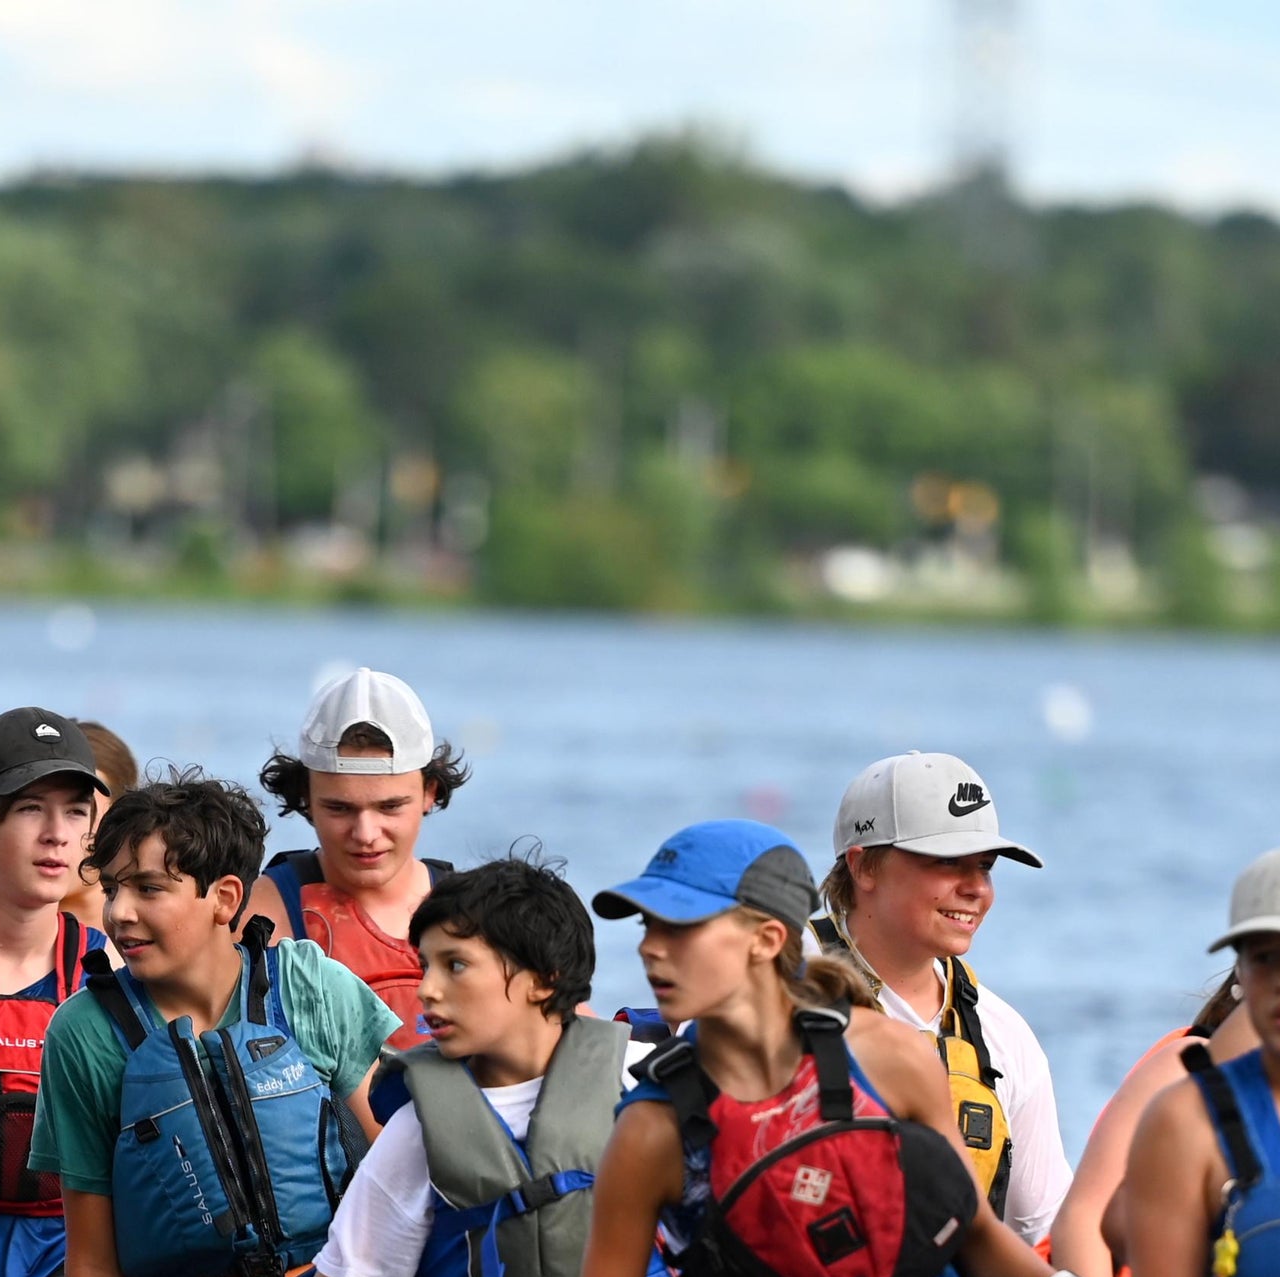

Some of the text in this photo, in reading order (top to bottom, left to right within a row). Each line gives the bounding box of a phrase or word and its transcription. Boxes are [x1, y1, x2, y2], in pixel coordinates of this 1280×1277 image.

[957, 782, 984, 803] NIKE
[256, 1078, 284, 1092] Eddy
[181, 1160, 213, 1225] SALUS
